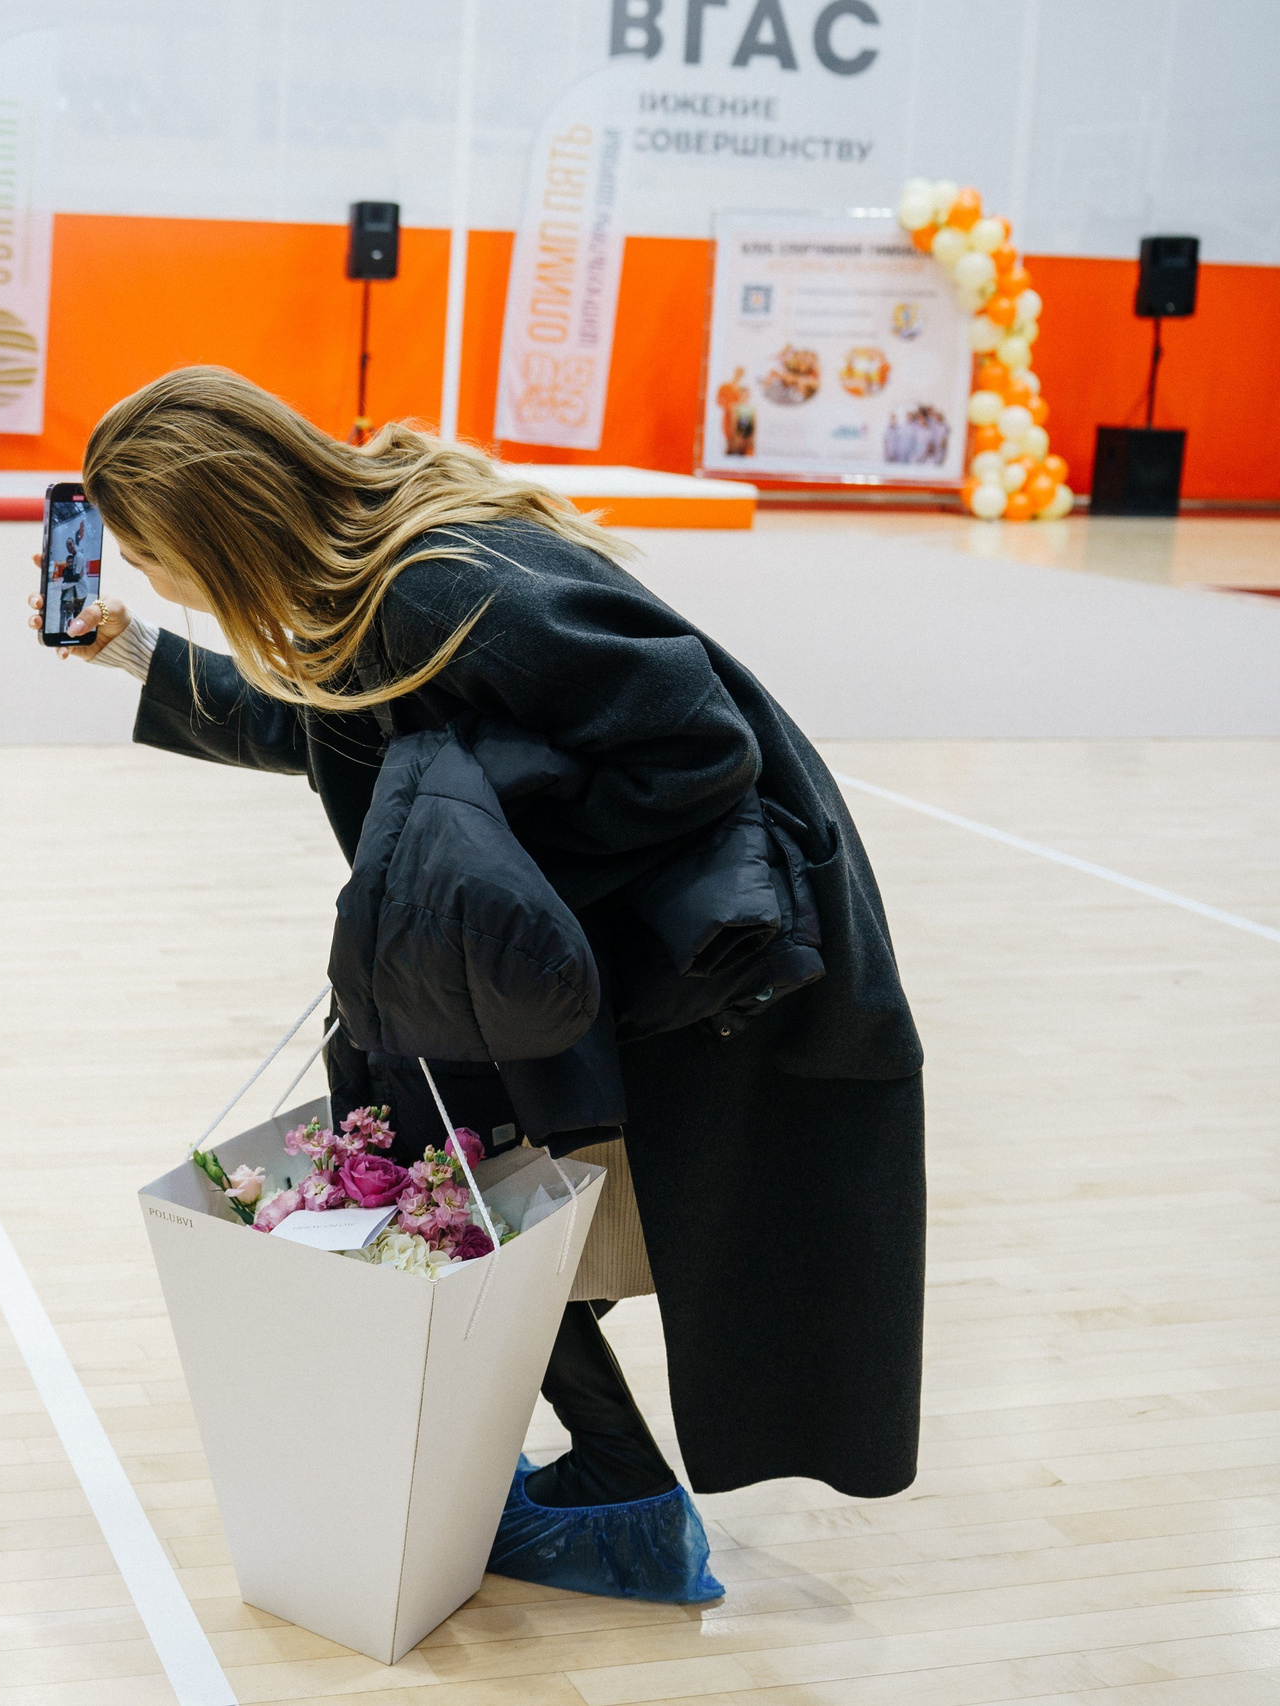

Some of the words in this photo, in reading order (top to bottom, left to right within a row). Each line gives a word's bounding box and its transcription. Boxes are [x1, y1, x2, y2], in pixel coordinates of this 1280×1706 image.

[609, 0, 881, 76] ВГАС
[543, 123, 592, 213] ПЯТЬ
[529, 220, 579, 343] ОЛИМП
[149, 1207, 194, 1228] POLUBVI
